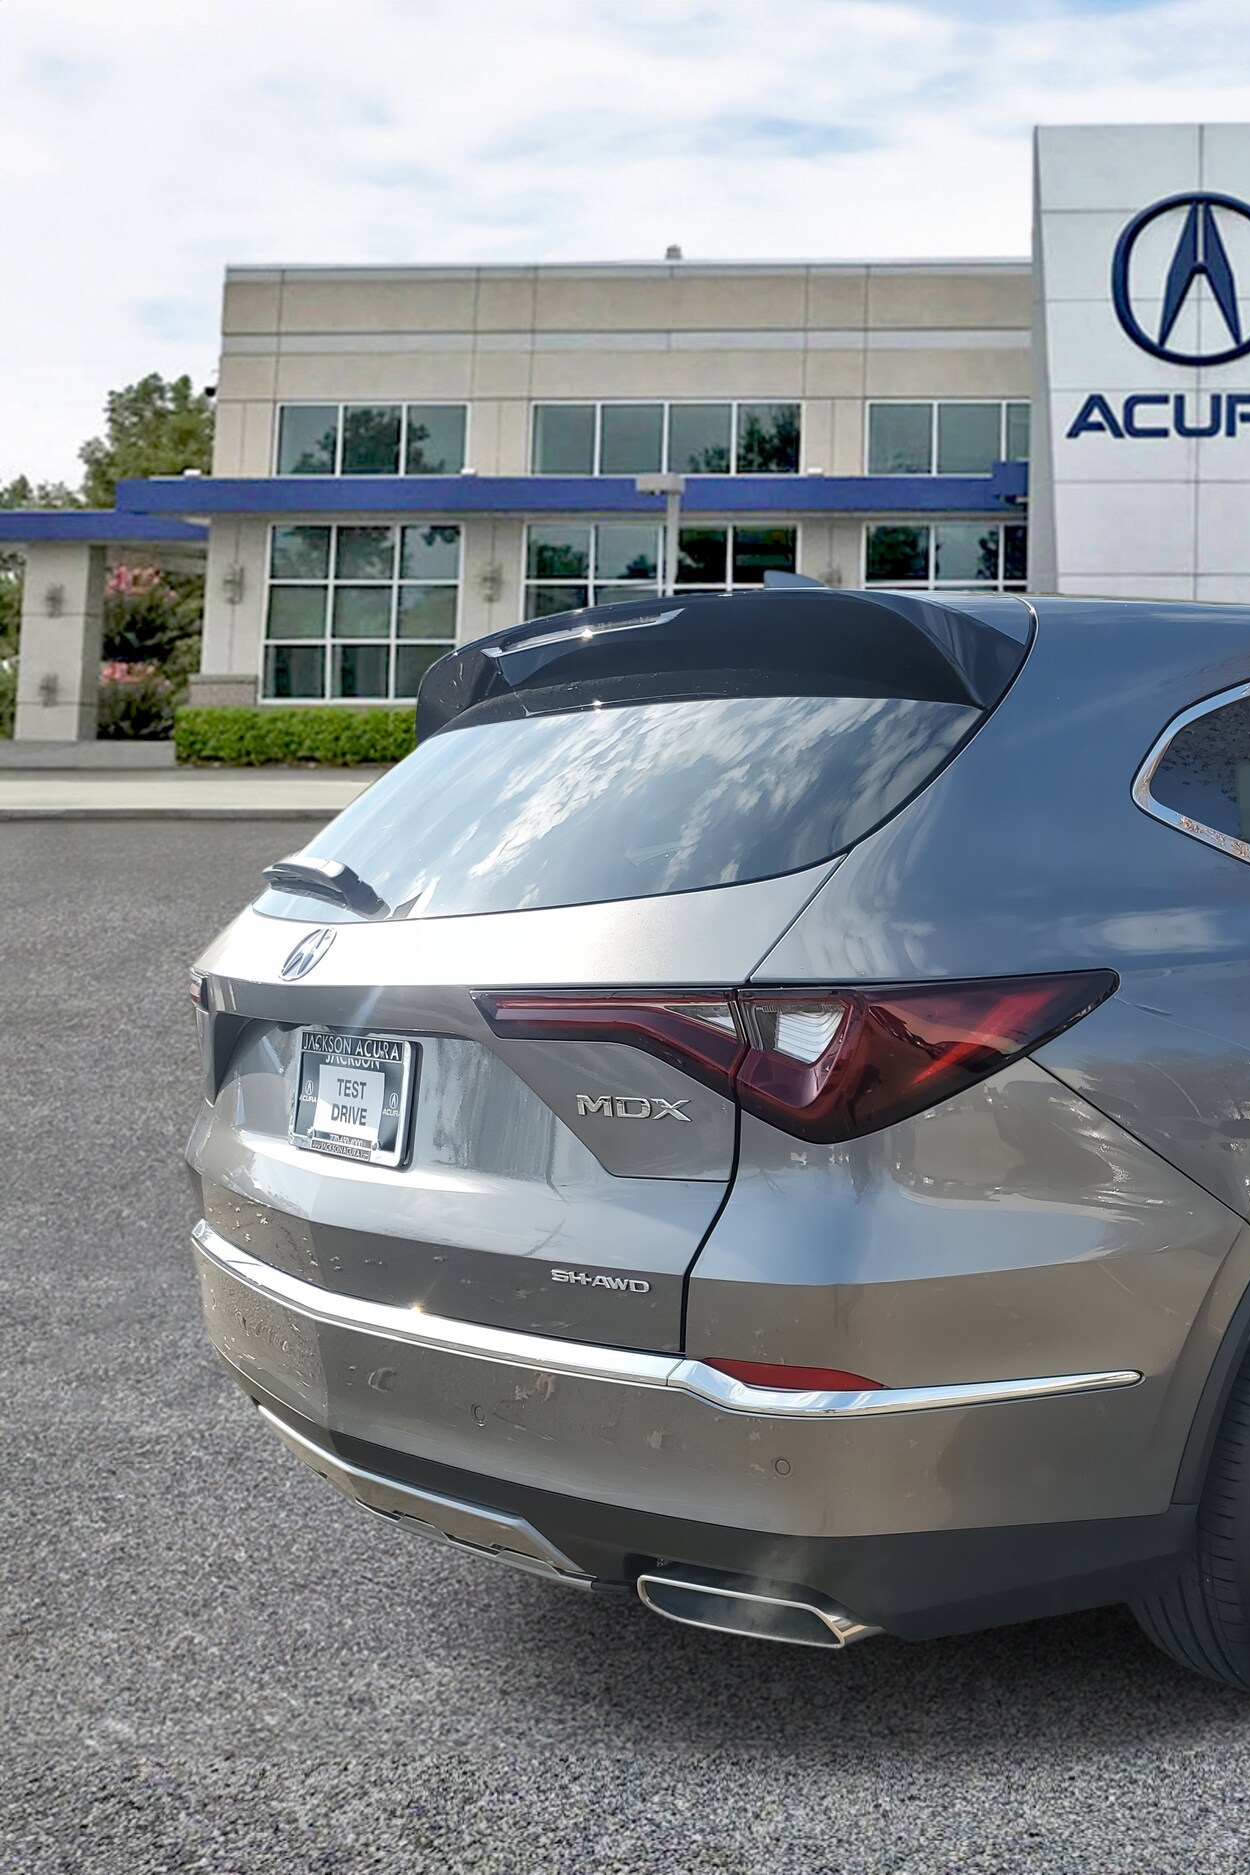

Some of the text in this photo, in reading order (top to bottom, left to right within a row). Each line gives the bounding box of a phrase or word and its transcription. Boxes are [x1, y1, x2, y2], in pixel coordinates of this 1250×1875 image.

[304, 1034, 399, 1061] JACKSON ACURA
[337, 1078, 367, 1100] TEST
[331, 1103, 368, 1126] DRIVE
[576, 1094, 692, 1122] MDX
[551, 1269, 651, 1293] SH-AWD
